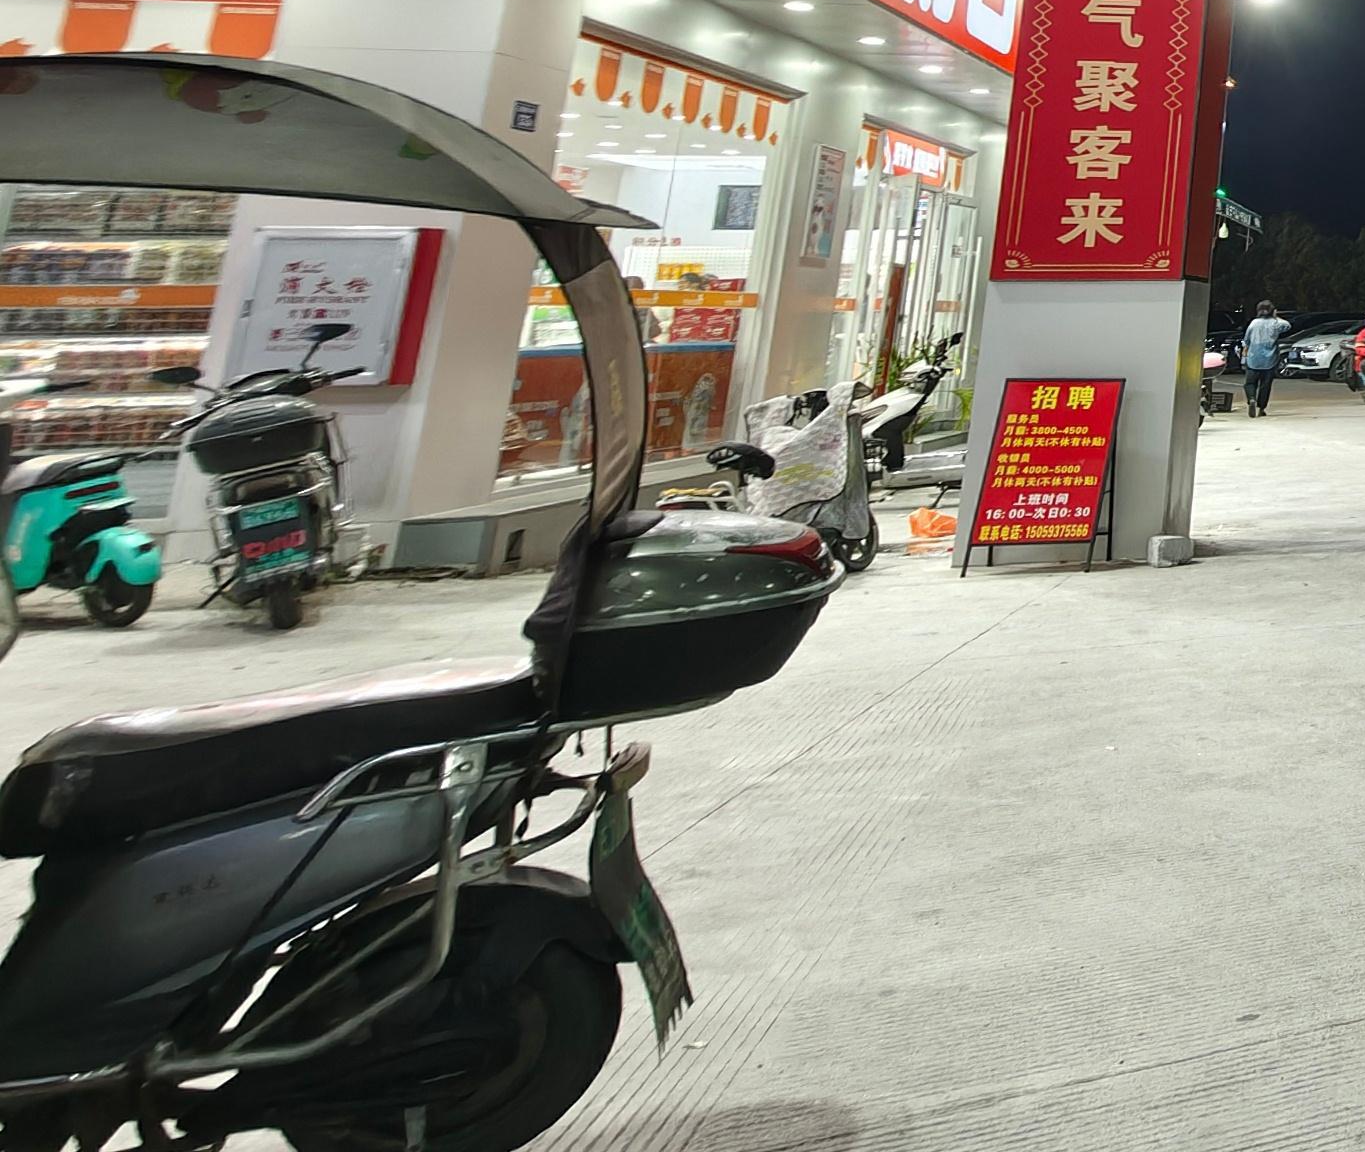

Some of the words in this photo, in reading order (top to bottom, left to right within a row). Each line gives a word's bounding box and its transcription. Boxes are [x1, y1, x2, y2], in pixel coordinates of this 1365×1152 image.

[1031, 385, 1096, 410] 招聘
[1012, 493, 1069, 506] 上班时间
